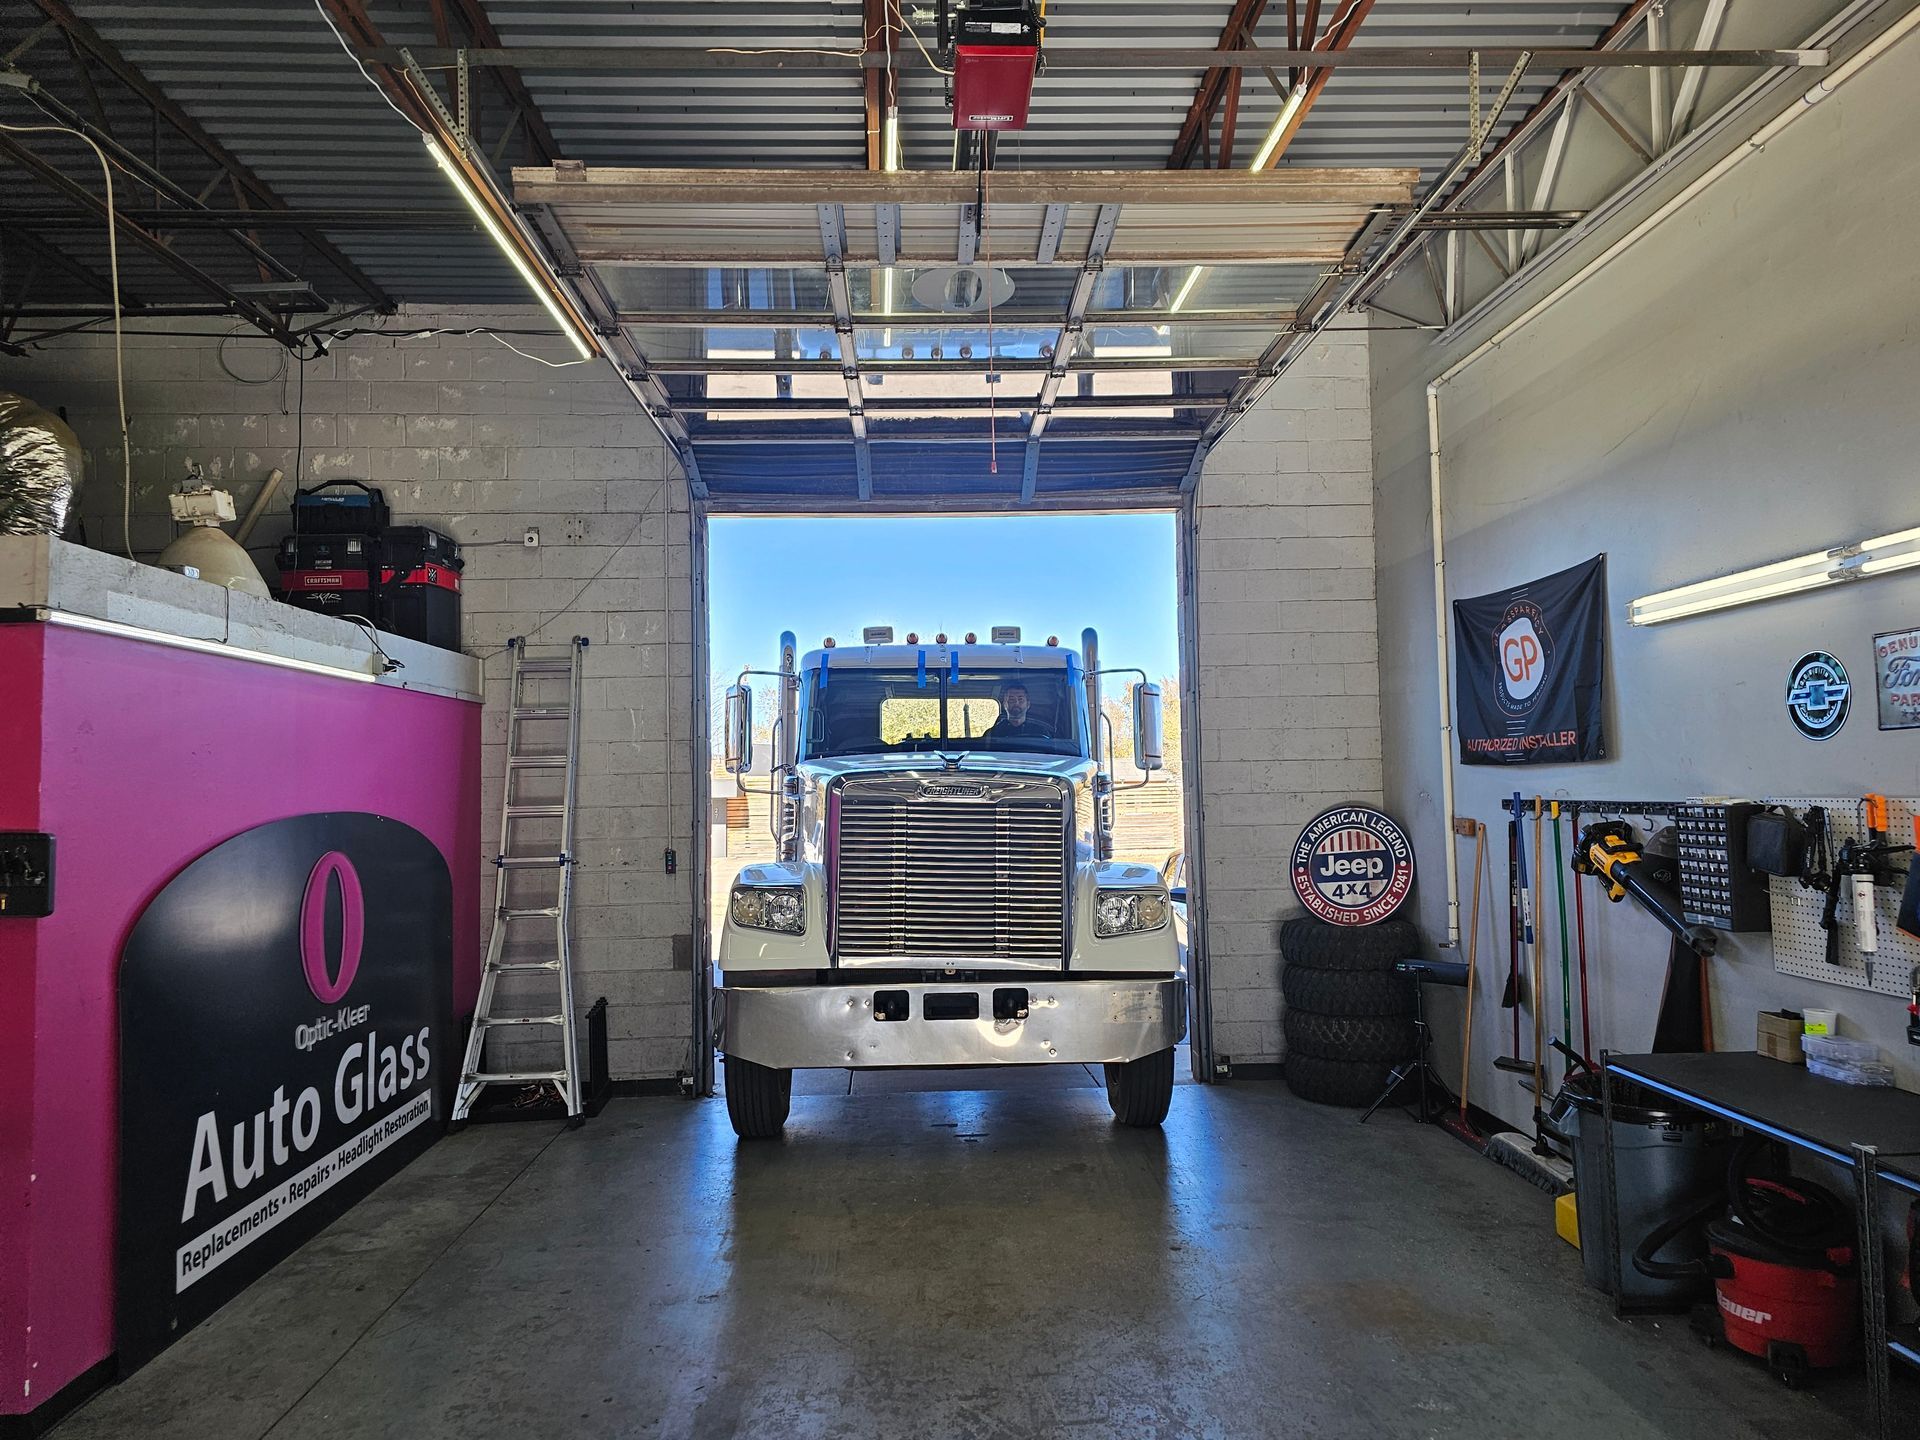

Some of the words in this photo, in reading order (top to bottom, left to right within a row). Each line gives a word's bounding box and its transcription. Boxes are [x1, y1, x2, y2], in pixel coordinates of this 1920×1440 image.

[1504, 634, 1538, 682] GP
[1878, 636, 1920, 658] GENU
[1467, 737, 1519, 752] AUTHORIZED
[1519, 730, 1577, 750] INSTALLER
[926, 786, 980, 796] FREIGHTLINER
[1297, 841, 1312, 864] THE
[1308, 812, 1368, 842] AMERICAN
[1370, 816, 1407, 858] LEGEND
[1320, 855, 1384, 879] Jeep
[1297, 875, 1360, 923] ESTABLISHED
[1363, 894, 1398, 921] SINCE
[1393, 869, 1409, 893] 1941
[295, 1004, 371, 1052] Optic-Kleer
[181, 1084, 322, 1224] Auto
[334, 1026, 431, 1125] Glass
[182, 1198, 280, 1276] Replacements
[289, 1161, 330, 1204] Repairs
[338, 1127, 383, 1171] Headlight
[384, 1098, 430, 1139] Restoration
